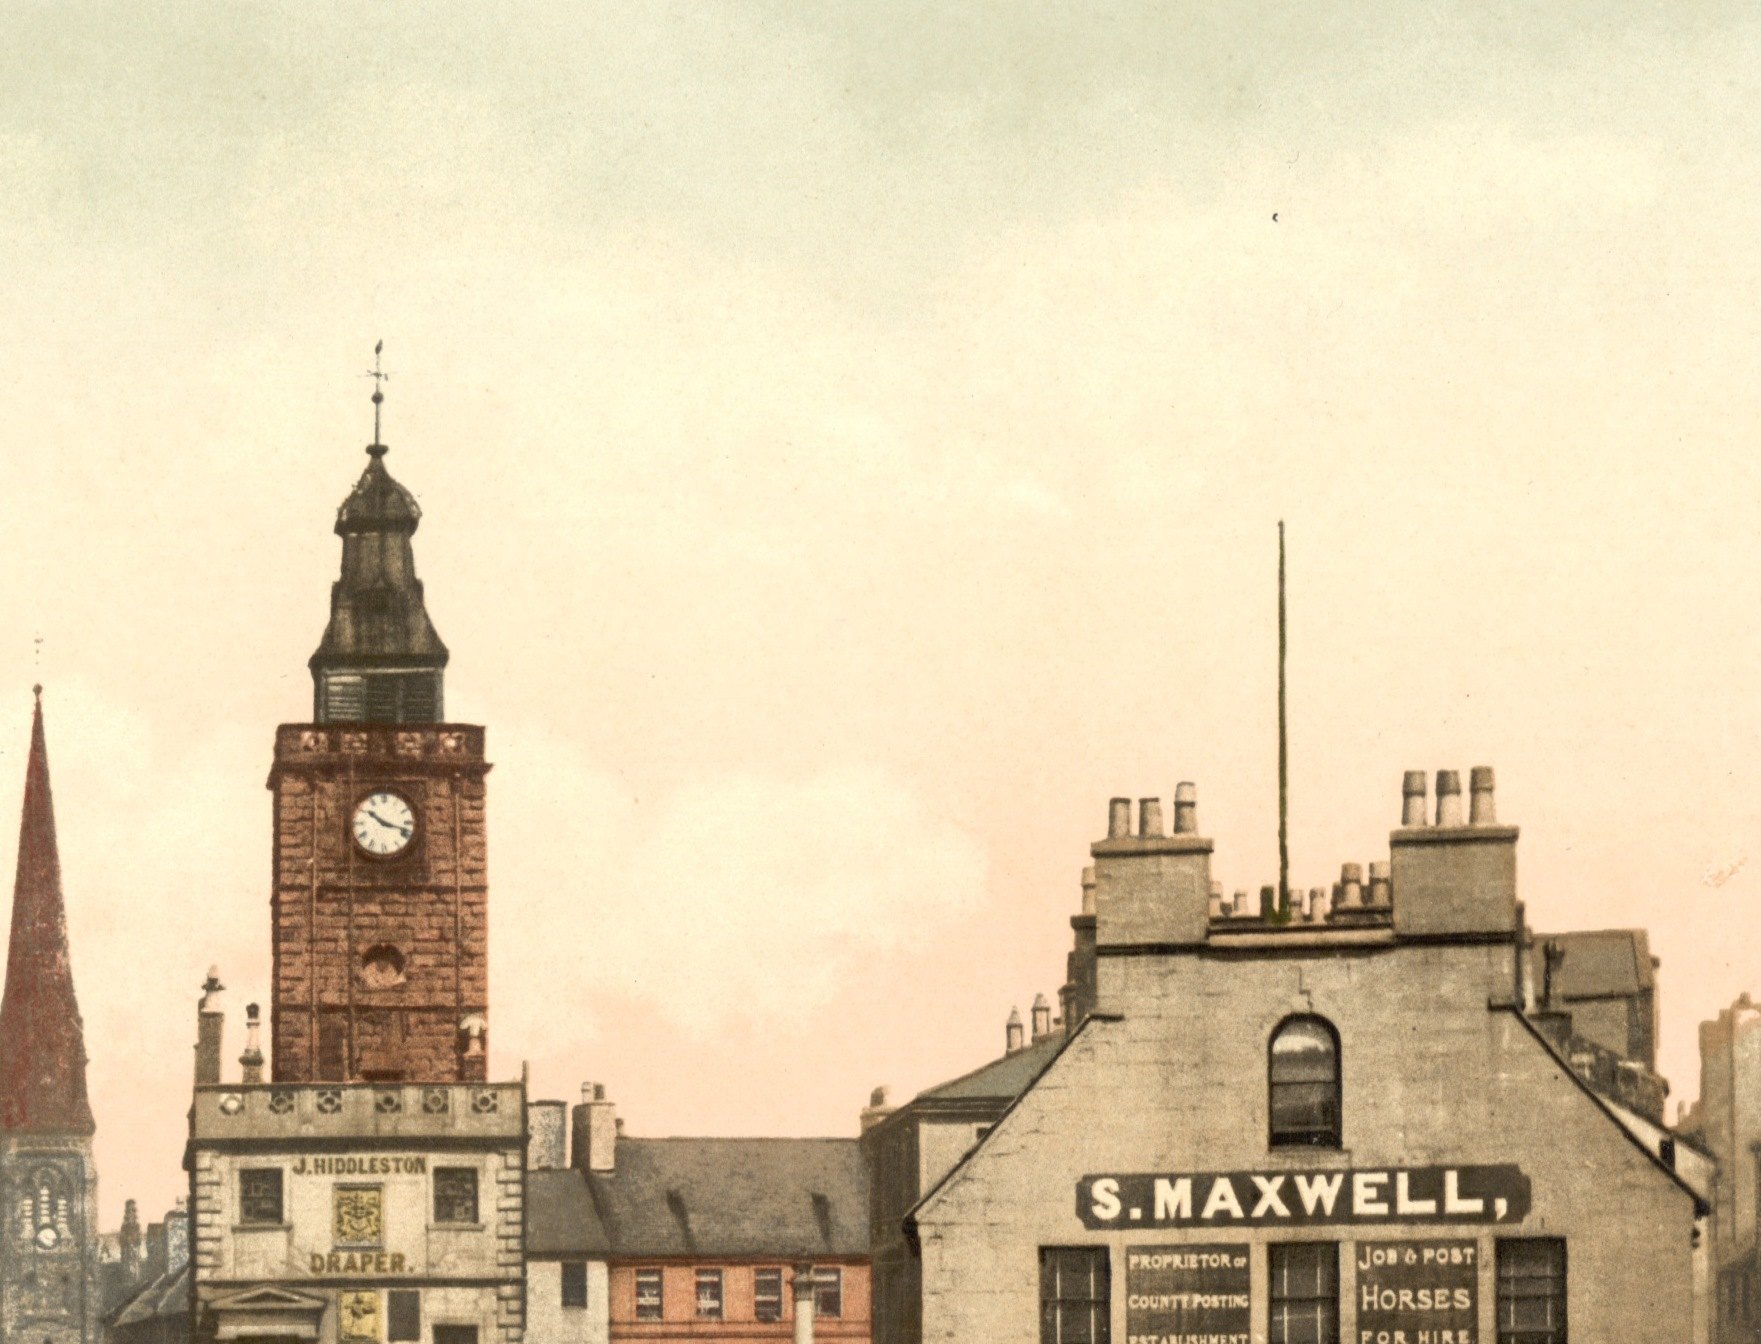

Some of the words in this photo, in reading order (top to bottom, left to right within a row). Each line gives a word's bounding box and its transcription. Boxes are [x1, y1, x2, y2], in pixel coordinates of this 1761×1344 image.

[309, 1252, 415, 1274] DRAPER.
[1128, 1253, 1231, 1270] PROPRIETOR
[1358, 1246, 1398, 1271] JOB
[1404, 1248, 1418, 1265] &
[1423, 1247, 1476, 1265] POST
[1128, 1294, 1190, 1310] COUNTY
[1191, 1293, 1249, 1309] POSTING
[1361, 1284, 1471, 1311] HORSES
